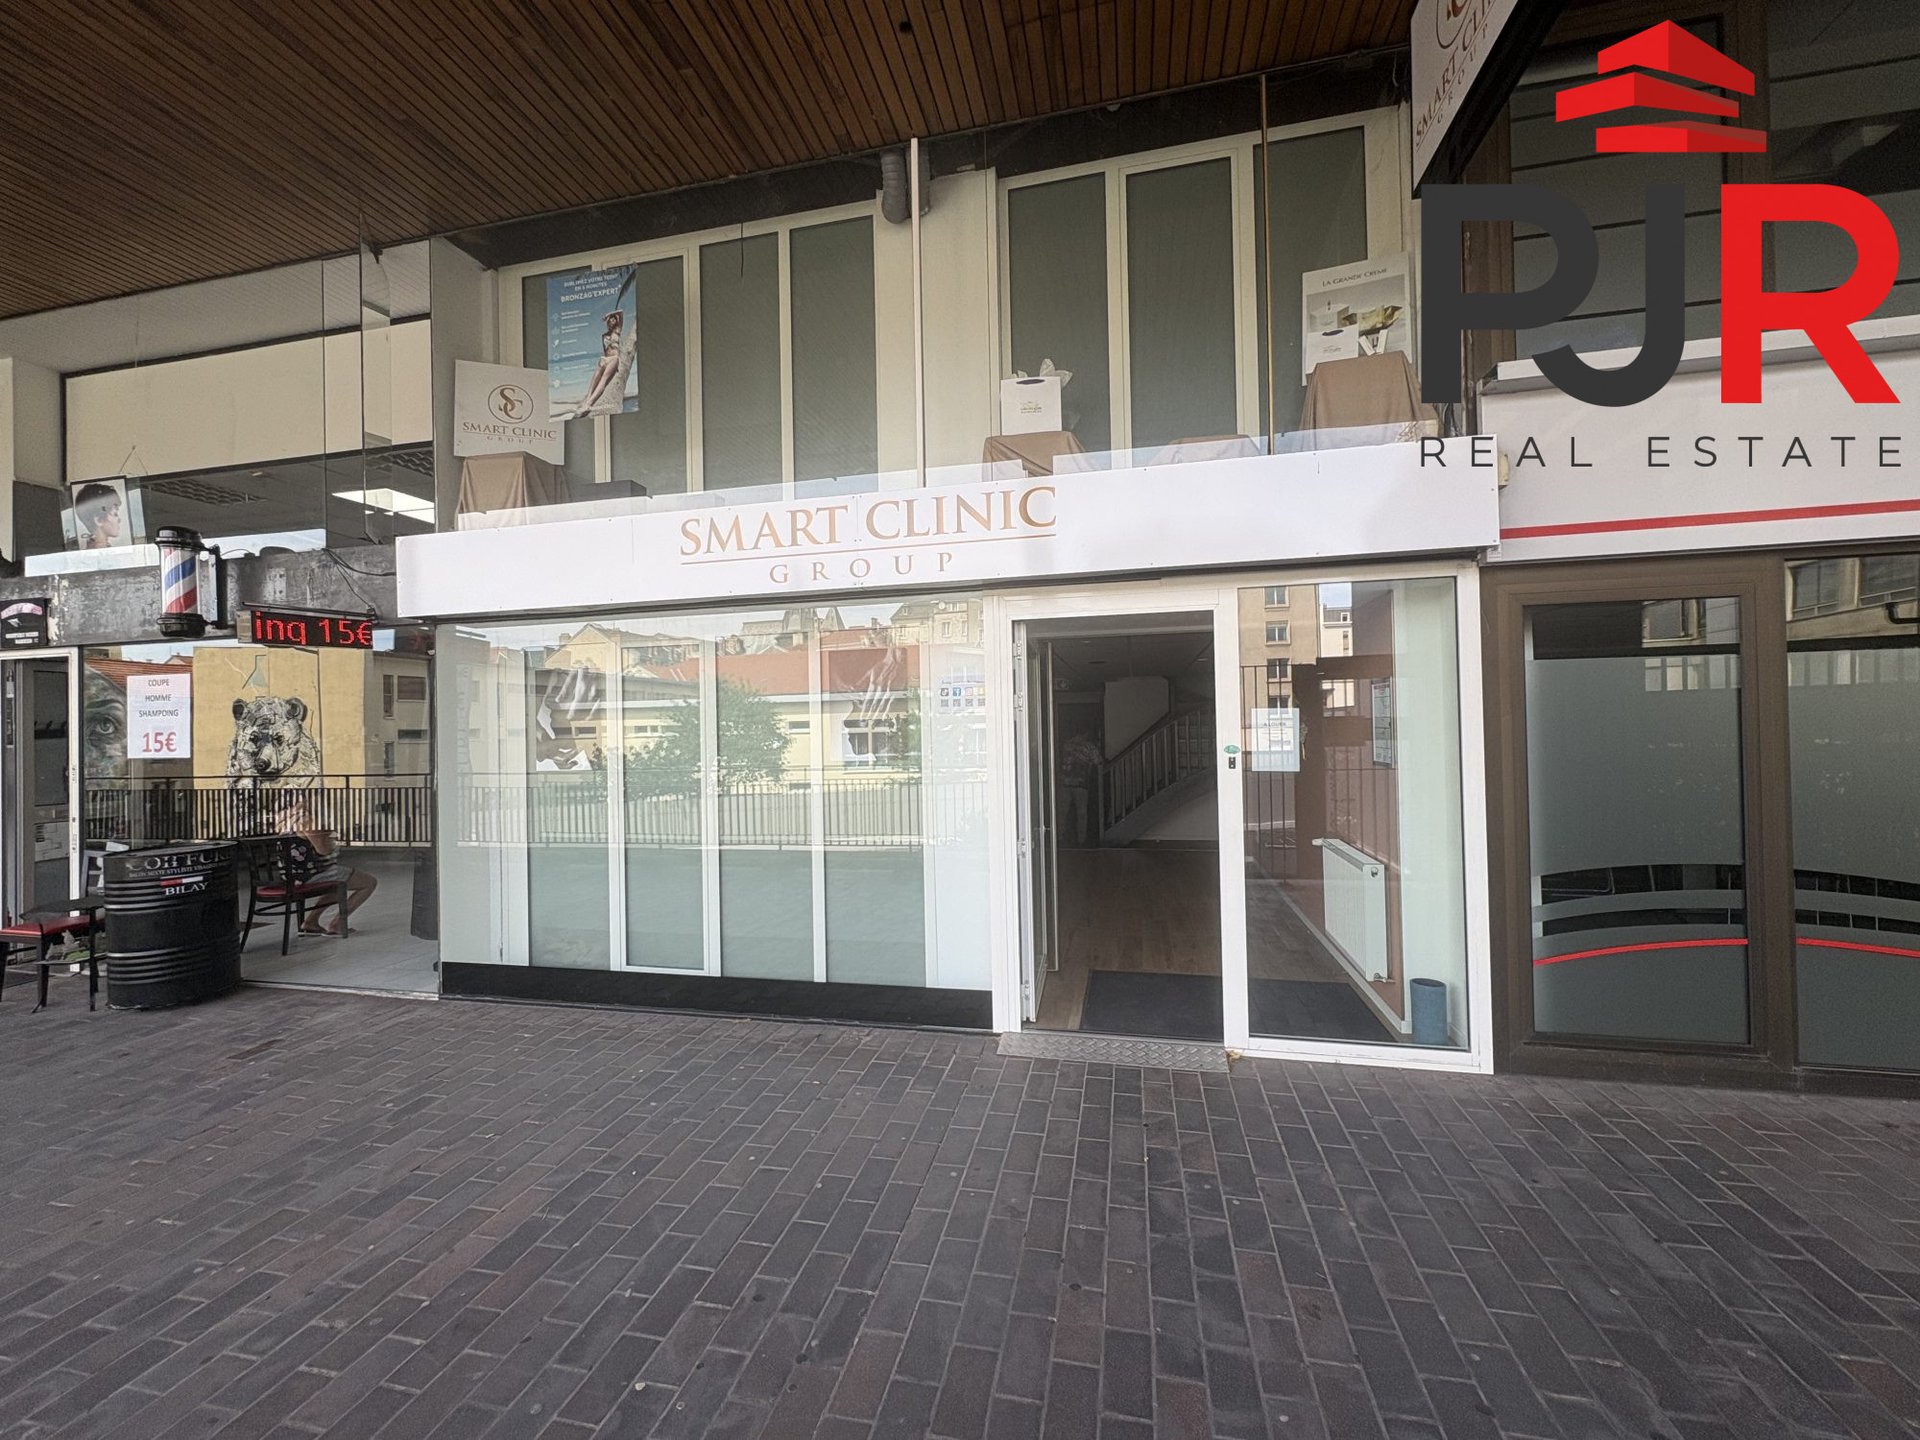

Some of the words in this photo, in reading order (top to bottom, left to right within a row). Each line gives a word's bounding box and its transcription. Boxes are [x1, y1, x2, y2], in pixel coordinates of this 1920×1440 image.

[1416, 46, 1459, 147] SMART
[1333, 273, 1362, 285] GRANDE
[463, 422, 509, 435] SMART
[512, 427, 557, 439] CLINIC
[680, 504, 848, 556] SMART
[865, 486, 1057, 540] CLINIC
[769, 552, 953, 584] GROUP
[319, 619, 372, 645] 15€
[148, 679, 170, 687] COUPE
[138, 709, 179, 717] SHAMPOING
[142, 731, 177, 753] 15€
[165, 881, 209, 896] BILAY
